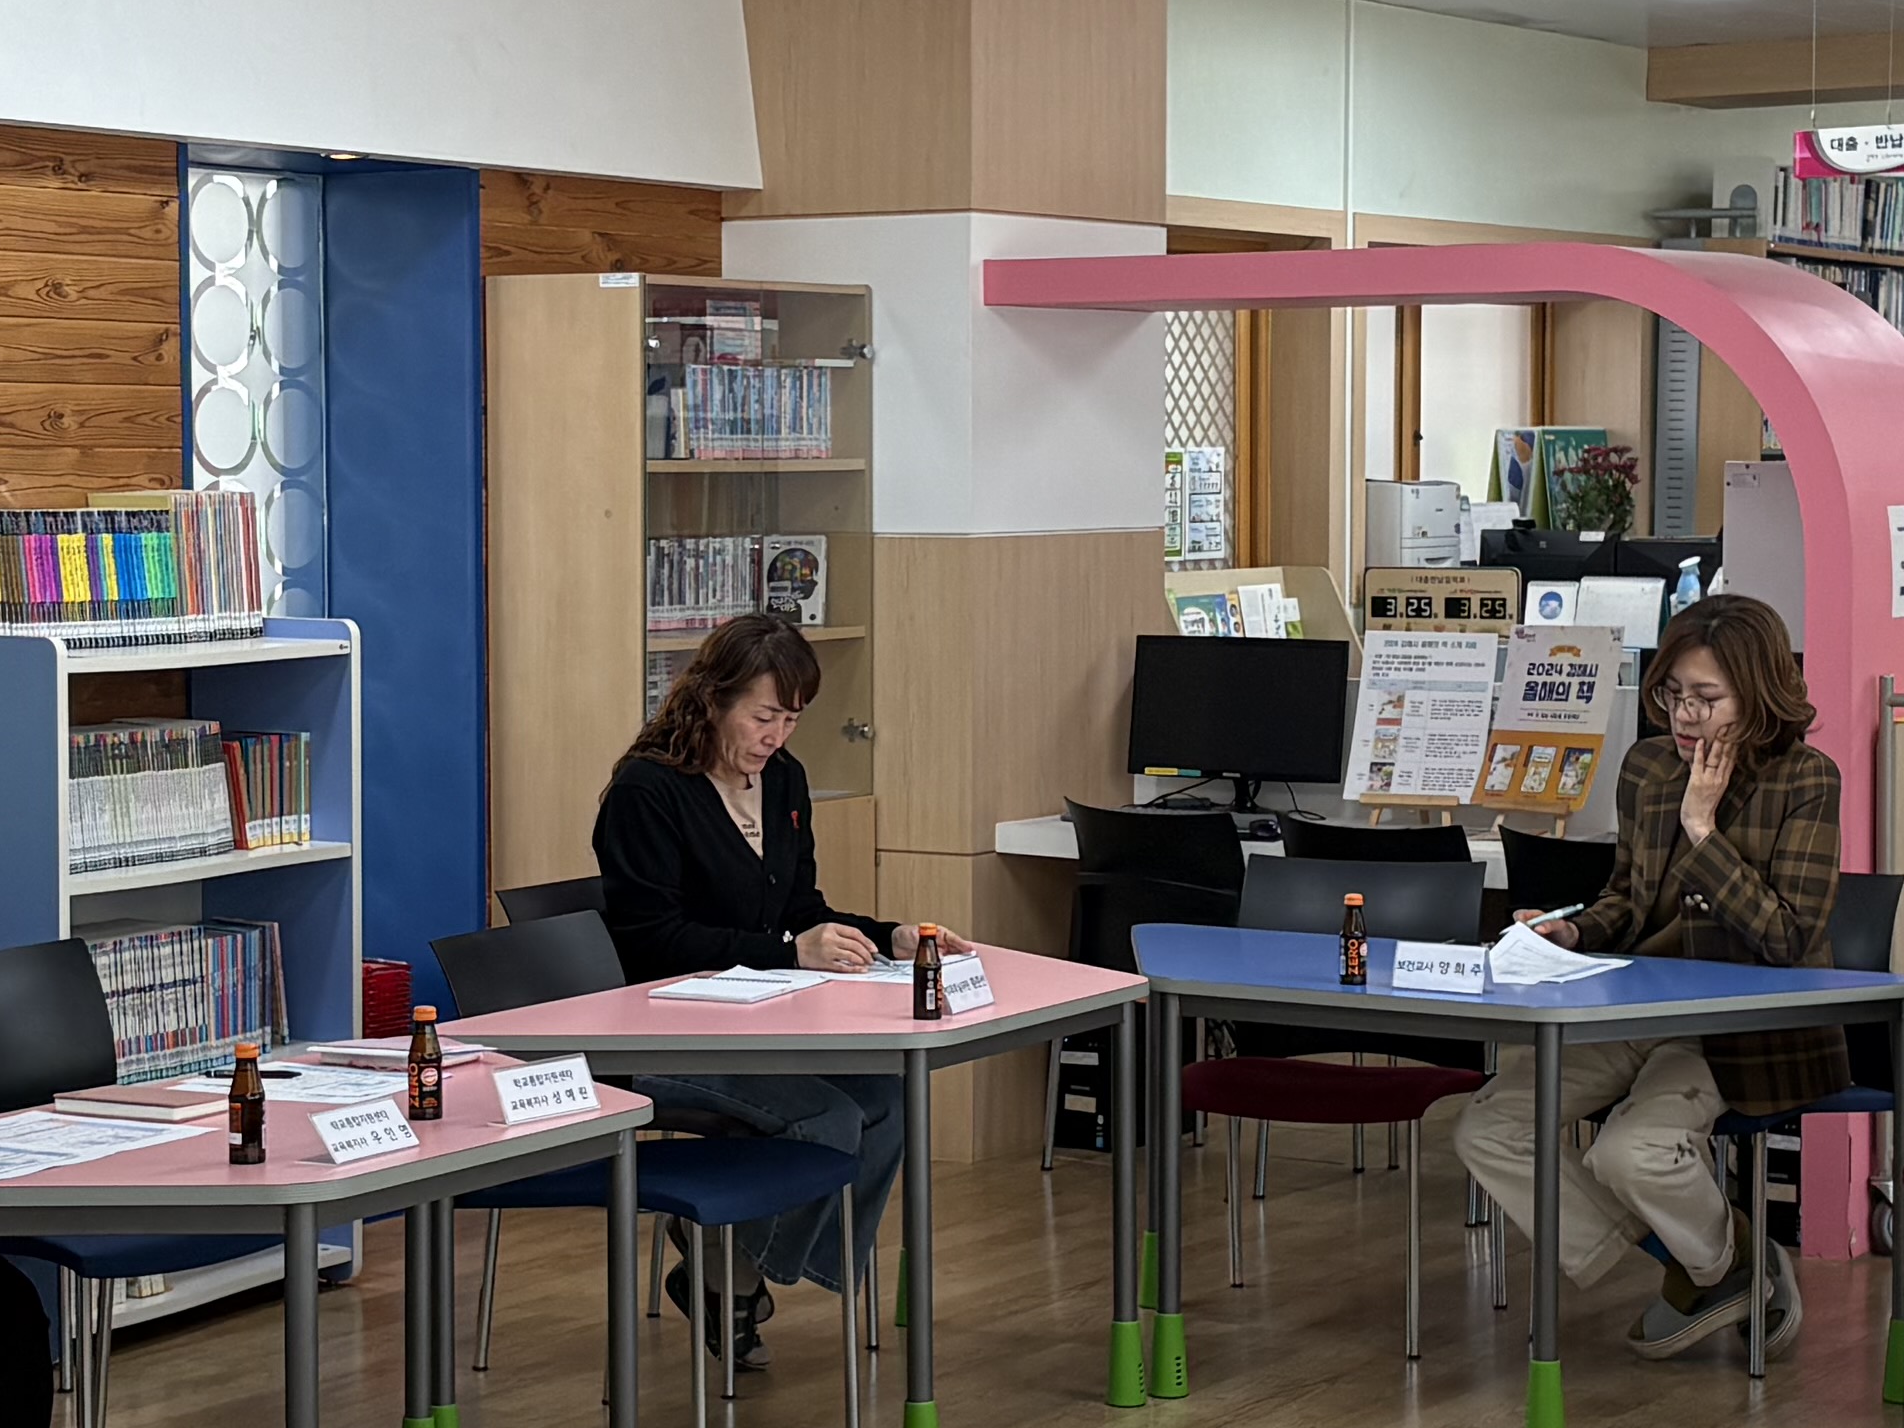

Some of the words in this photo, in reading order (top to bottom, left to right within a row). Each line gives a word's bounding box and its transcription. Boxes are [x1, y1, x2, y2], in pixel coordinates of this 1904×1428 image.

[1831, 136, 1858, 151] 대출
[1875, 133, 1904, 149] 반납
[1386, 599, 1396, 616] 3
[1407, 599, 1431, 616] 25
[1460, 599, 1470, 616] 3
[1481, 599, 1505, 617] 25
[1526, 662, 1564, 677] 2024
[1522, 680, 1572, 702] 올해의
[1576, 680, 1596, 704] 책
[1347, 938, 1359, 975] ZERO
